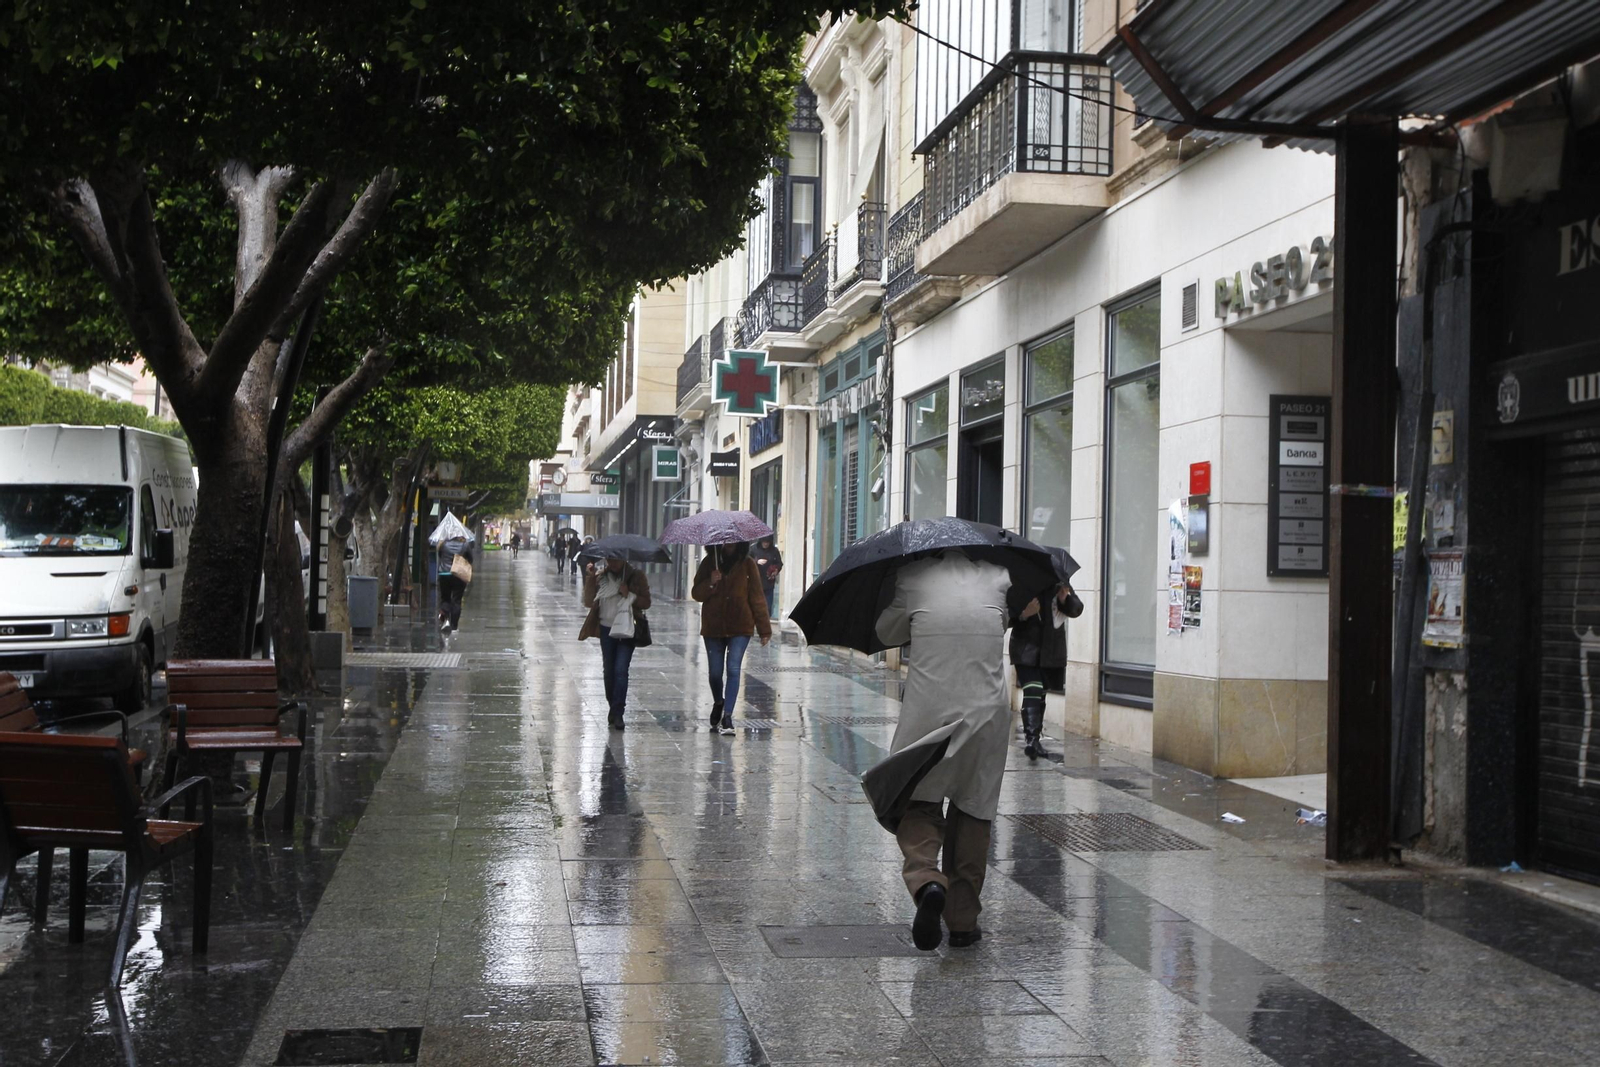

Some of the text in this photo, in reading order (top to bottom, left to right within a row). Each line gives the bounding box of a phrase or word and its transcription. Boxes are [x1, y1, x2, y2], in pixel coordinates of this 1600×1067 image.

[1214, 235, 1334, 318] PASEO 2
[1280, 403, 1326, 413] PASEO 21
[1287, 448, 1317, 459] Bankia
[1430, 562, 1462, 575] VIVALDI
